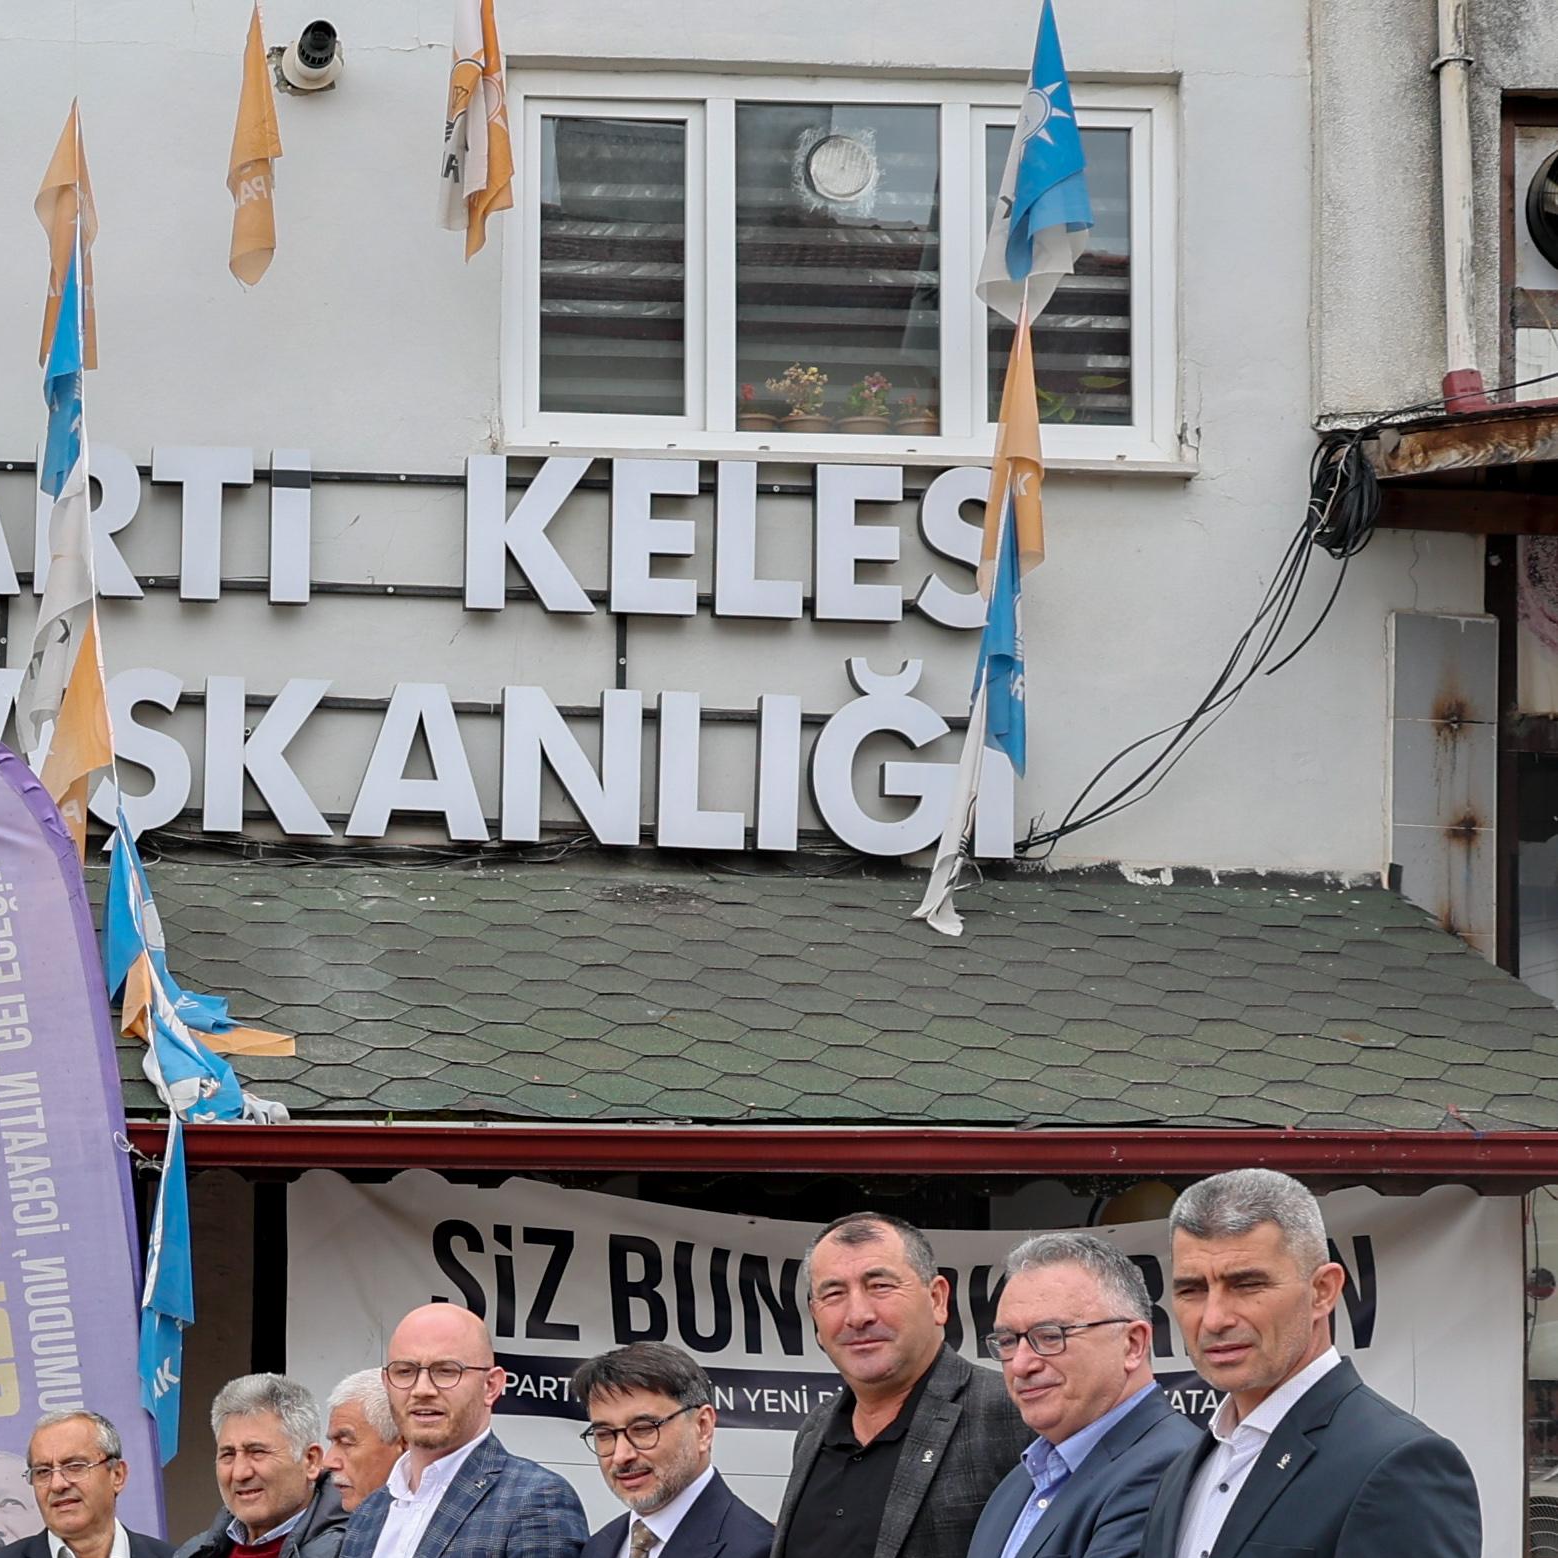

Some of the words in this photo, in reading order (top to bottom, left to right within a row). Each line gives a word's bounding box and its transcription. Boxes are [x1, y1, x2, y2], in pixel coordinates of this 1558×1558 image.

[464, 454, 990, 630] KELES
[432, 1219, 580, 1341] SİZ
[609, 1234, 804, 1356] BUN
[501, 1371, 581, 1402] PART
[742, 1384, 809, 1414] YENİ
